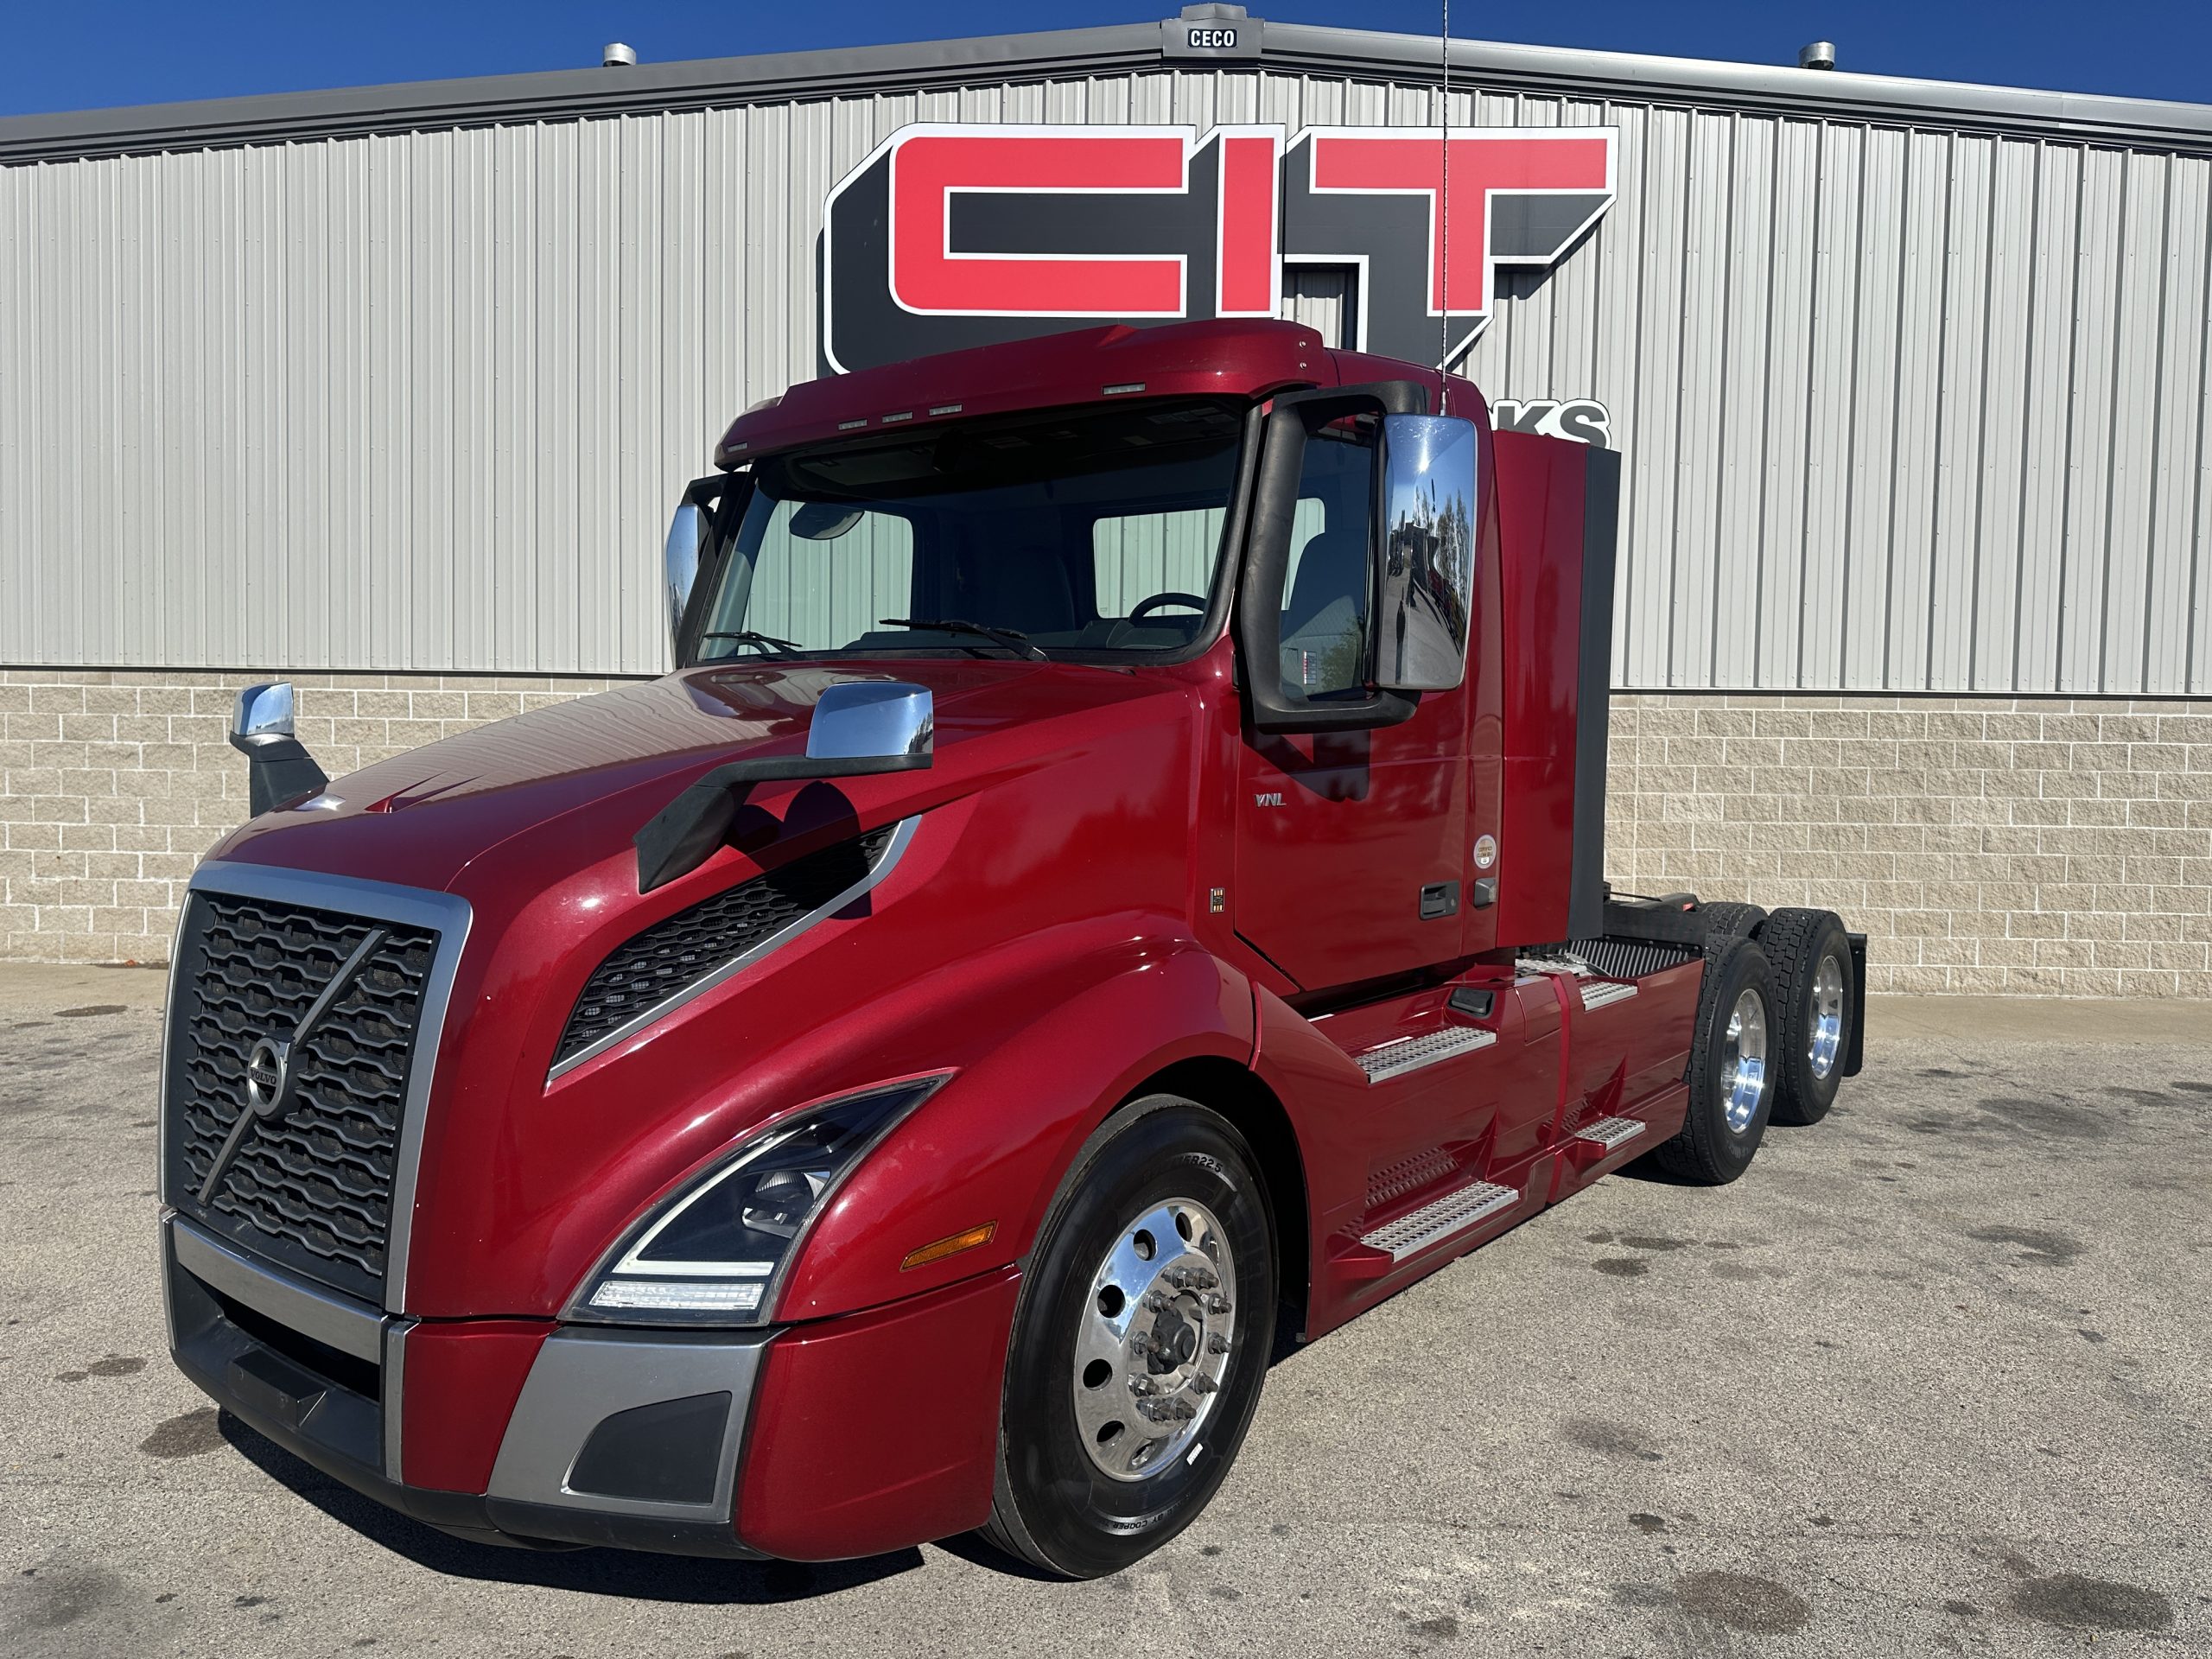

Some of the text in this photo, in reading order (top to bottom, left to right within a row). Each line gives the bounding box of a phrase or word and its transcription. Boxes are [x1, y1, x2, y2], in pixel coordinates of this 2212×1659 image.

[1191, 30, 1235, 47] CECO
[887, 124, 1618, 320] CIT
[1497, 404, 1607, 449] KS
[1255, 792, 1287, 807] VNL
[250, 1069, 277, 1085] VOLVO
[1112, 1519, 1147, 1530] COOPER
